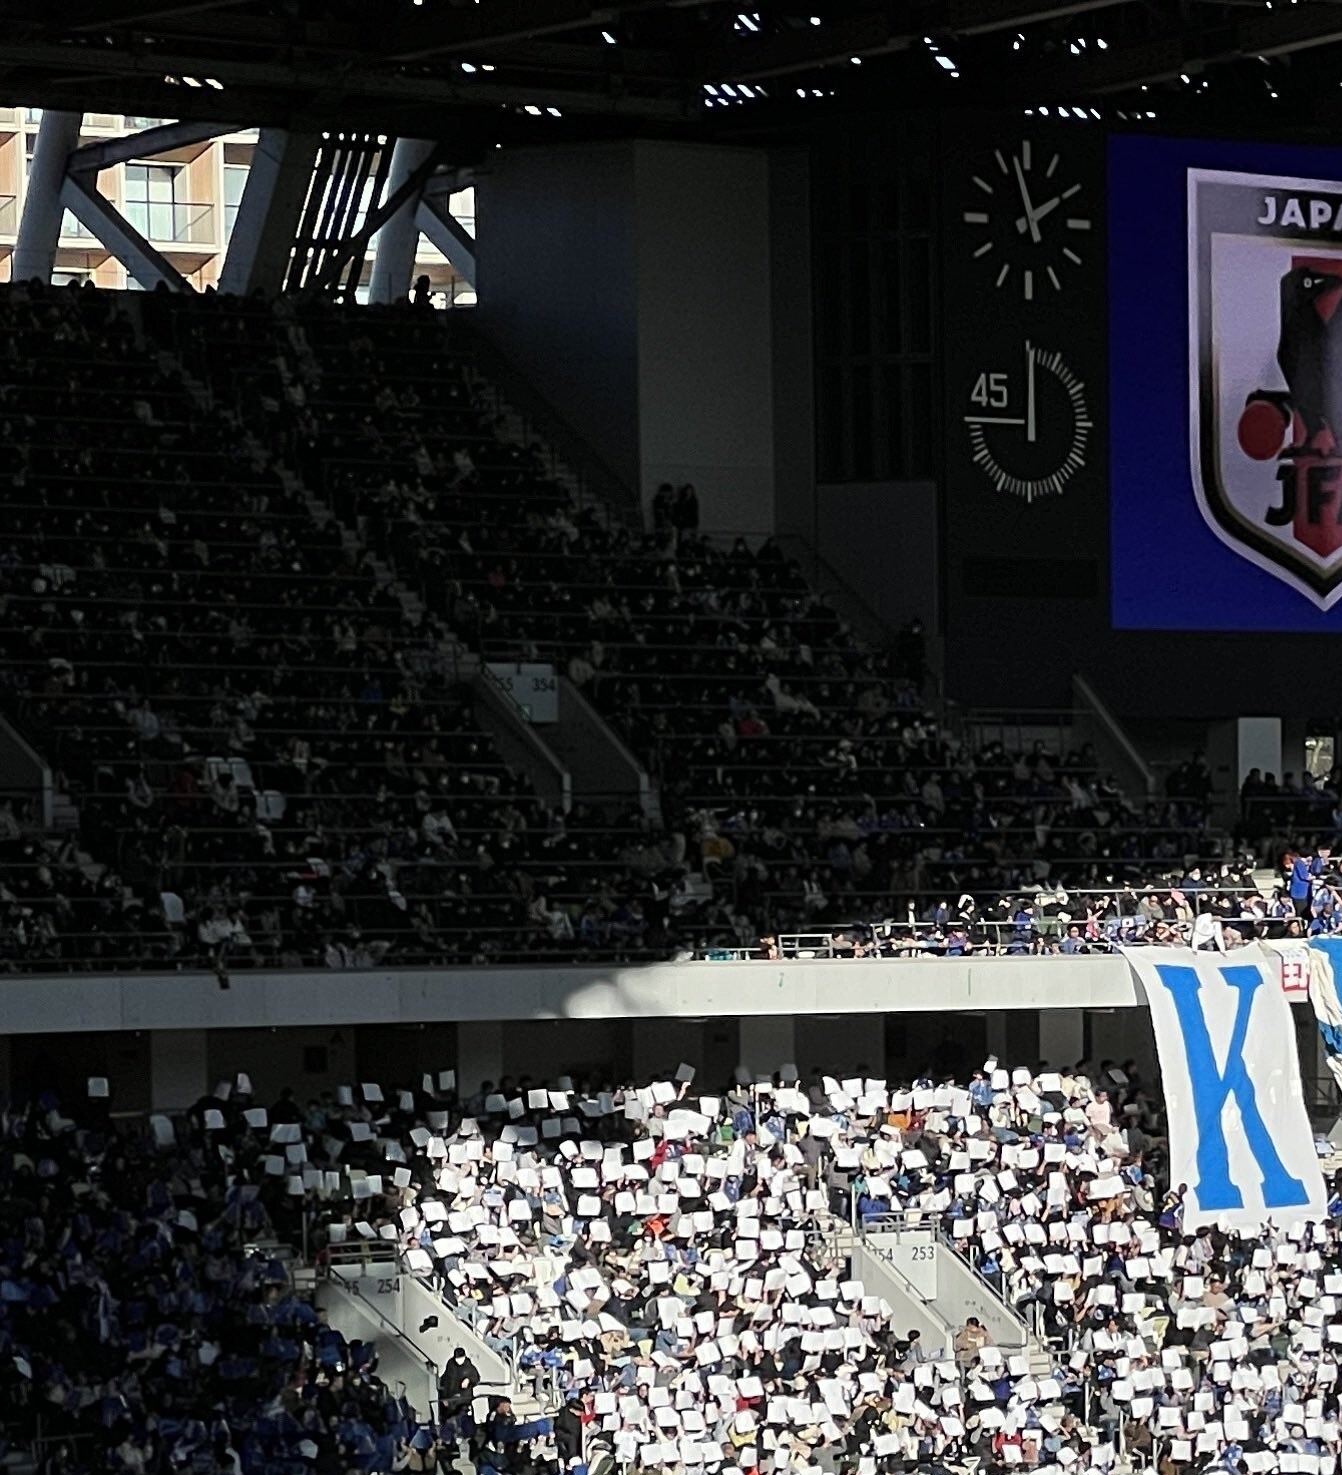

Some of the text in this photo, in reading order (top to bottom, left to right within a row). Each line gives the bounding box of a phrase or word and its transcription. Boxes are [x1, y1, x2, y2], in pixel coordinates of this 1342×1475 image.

[970, 372, 1009, 408] 45
[911, 1246, 935, 1261] 253
[377, 1278, 401, 1294] 254
